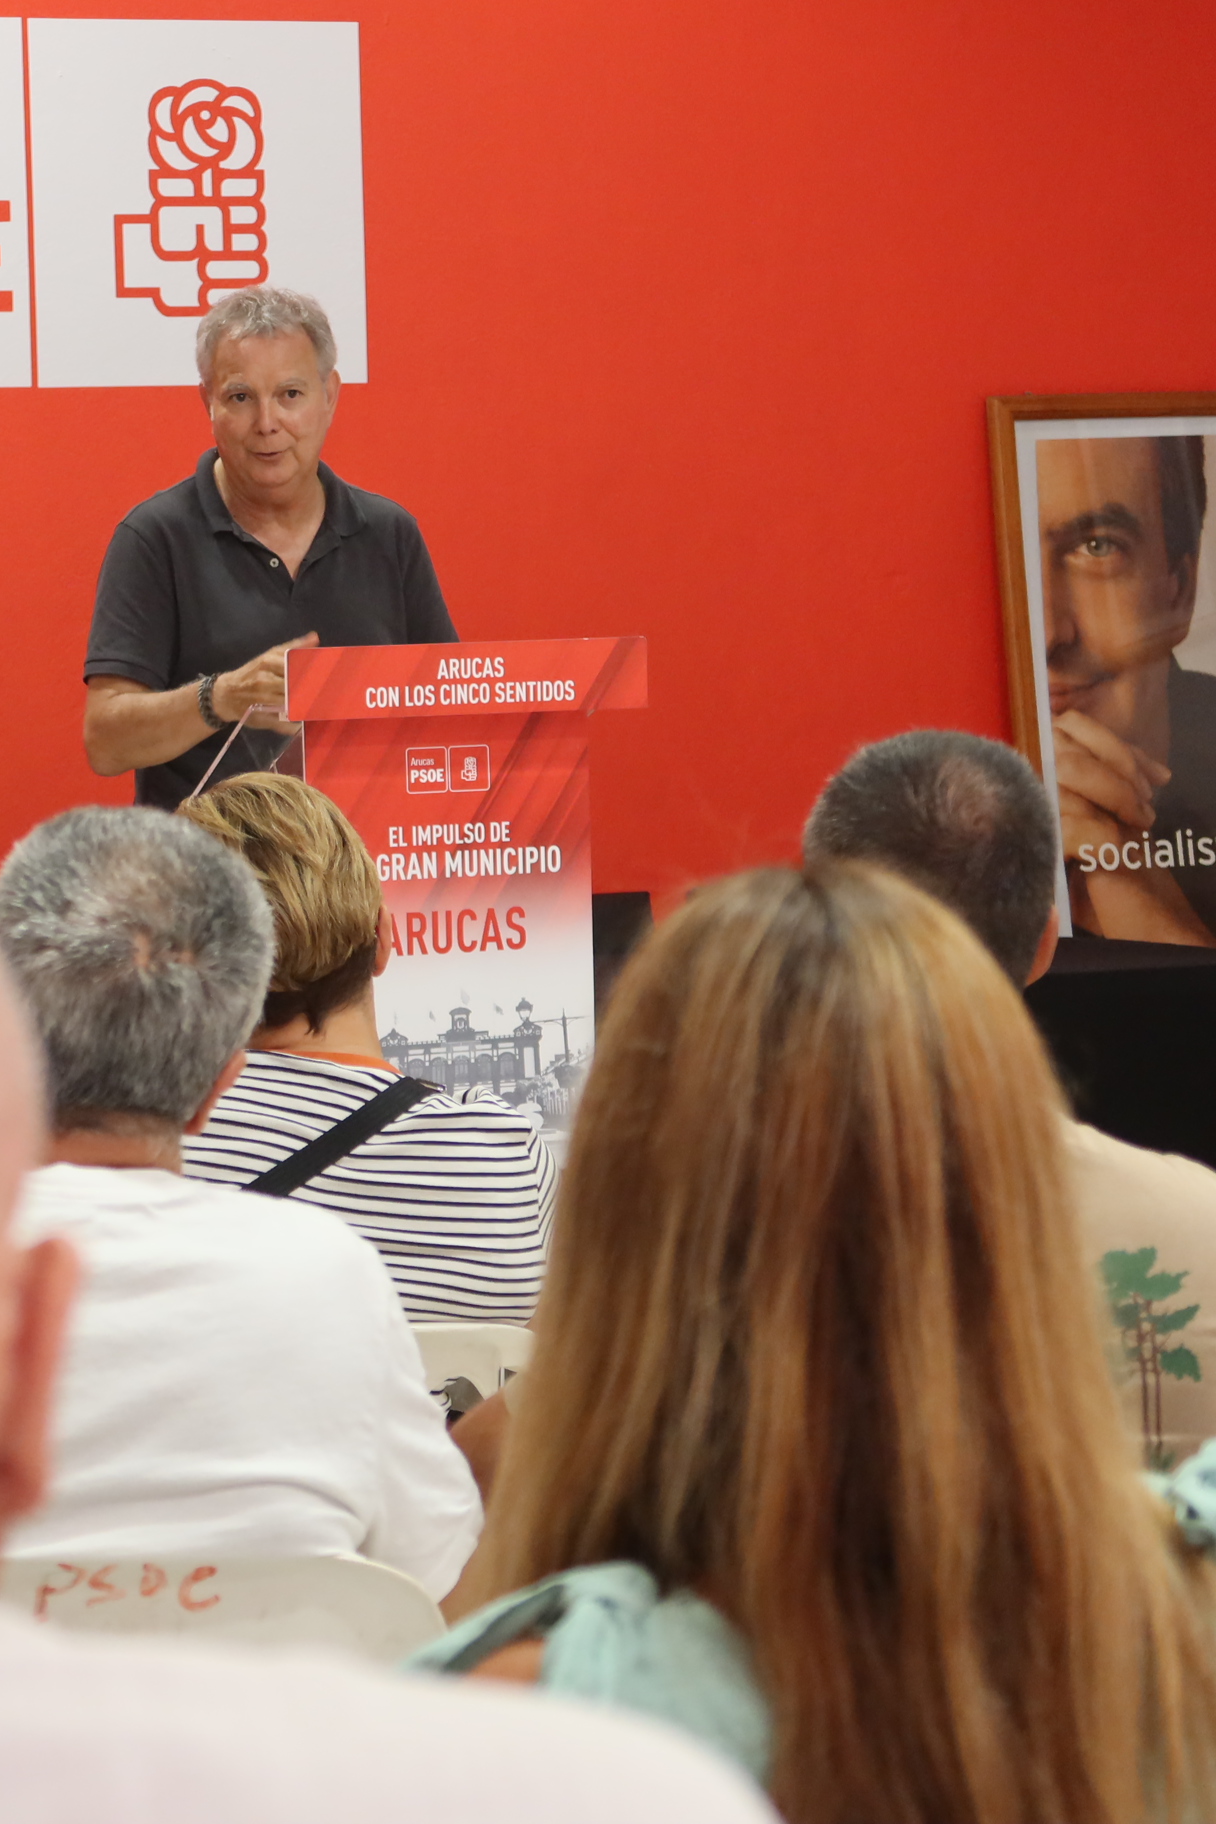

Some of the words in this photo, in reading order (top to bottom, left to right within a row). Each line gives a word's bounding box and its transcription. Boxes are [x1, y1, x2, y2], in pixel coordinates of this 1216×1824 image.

[437, 657, 505, 680] ARUCAS
[365, 686, 400, 708] CON
[405, 685, 436, 707] LOS
[440, 683, 491, 706] CINCO
[495, 680, 576, 704] SENTIDOS
[410, 757, 435, 766] Arucas
[410, 768, 445, 783] PSOE
[388, 826, 408, 848] EL
[412, 822, 486, 847] IMPULSO
[490, 821, 511, 843] DE
[376, 851, 439, 882] GRAN
[445, 845, 562, 878] MUNICIPIO
[1078, 828, 1216, 873] socialis
